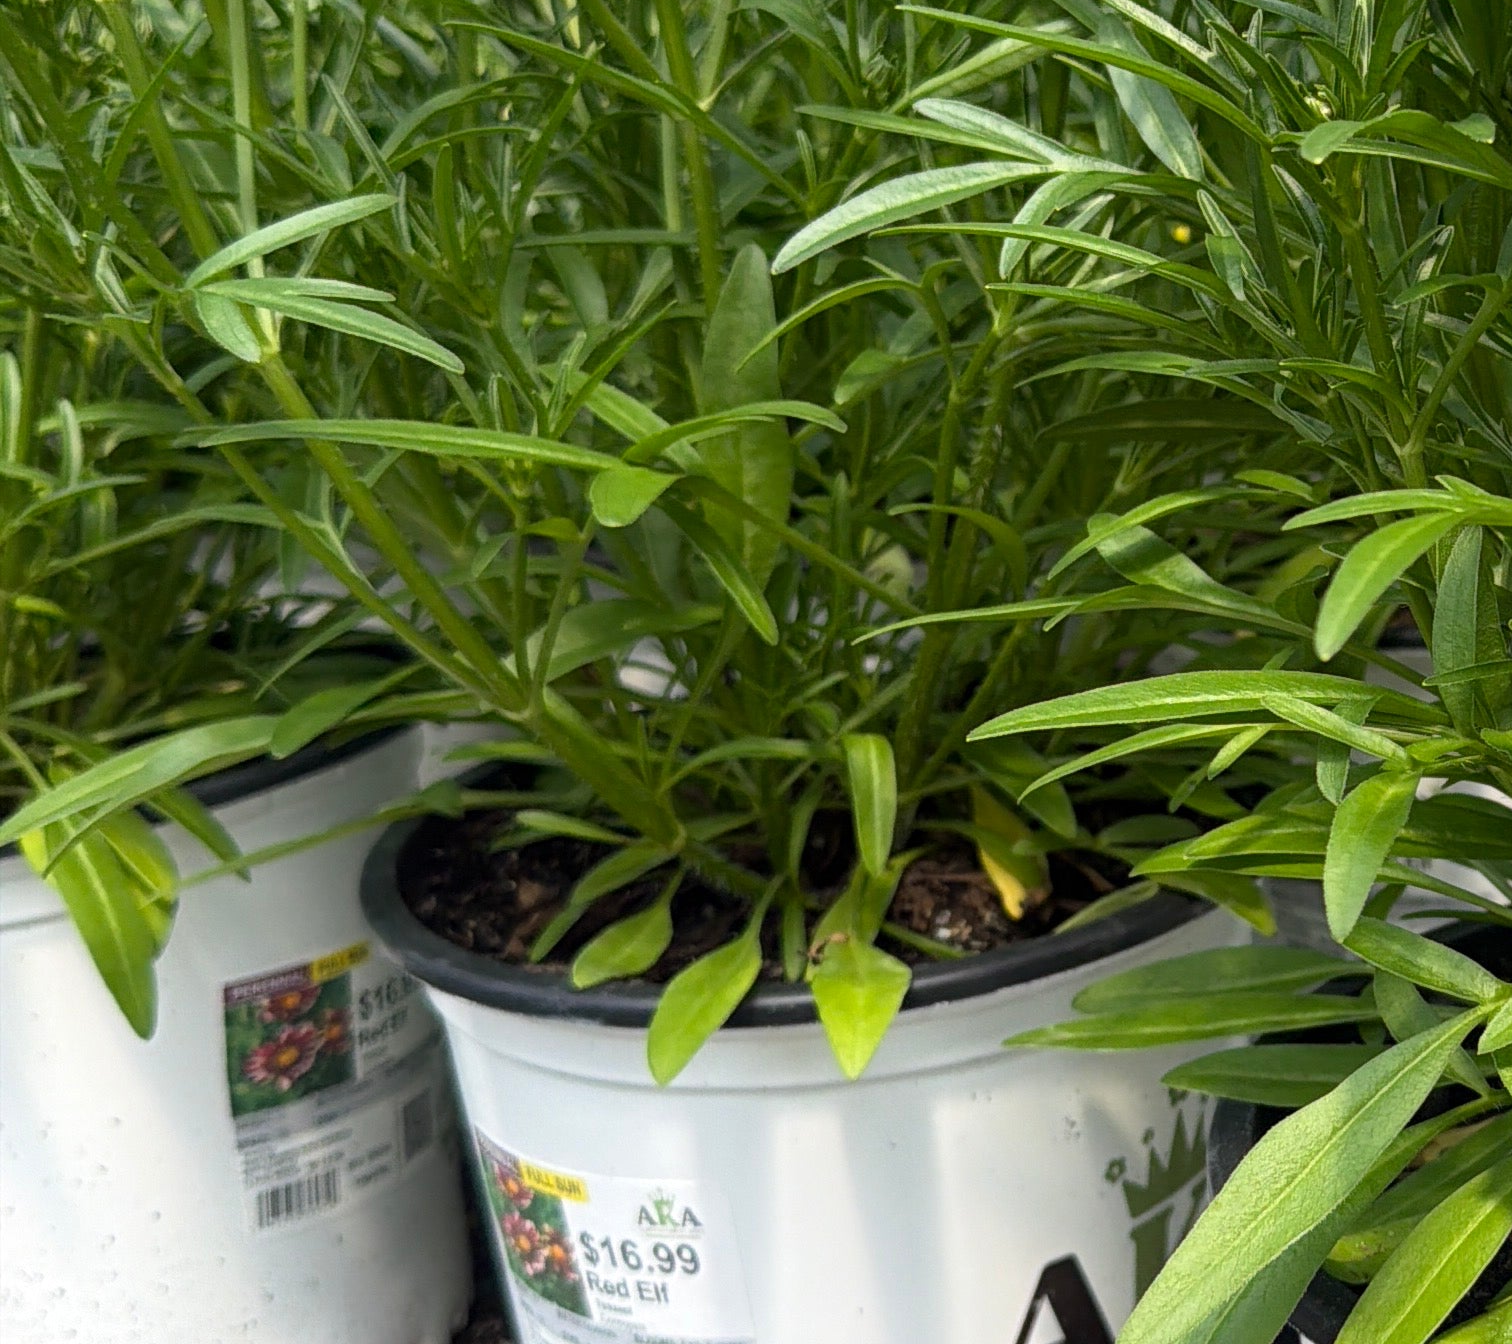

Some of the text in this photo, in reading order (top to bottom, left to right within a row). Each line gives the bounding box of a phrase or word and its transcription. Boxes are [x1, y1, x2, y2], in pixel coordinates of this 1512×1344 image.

[579, 1231, 701, 1275] $16.99
[586, 1270, 669, 1304] Red Elf
